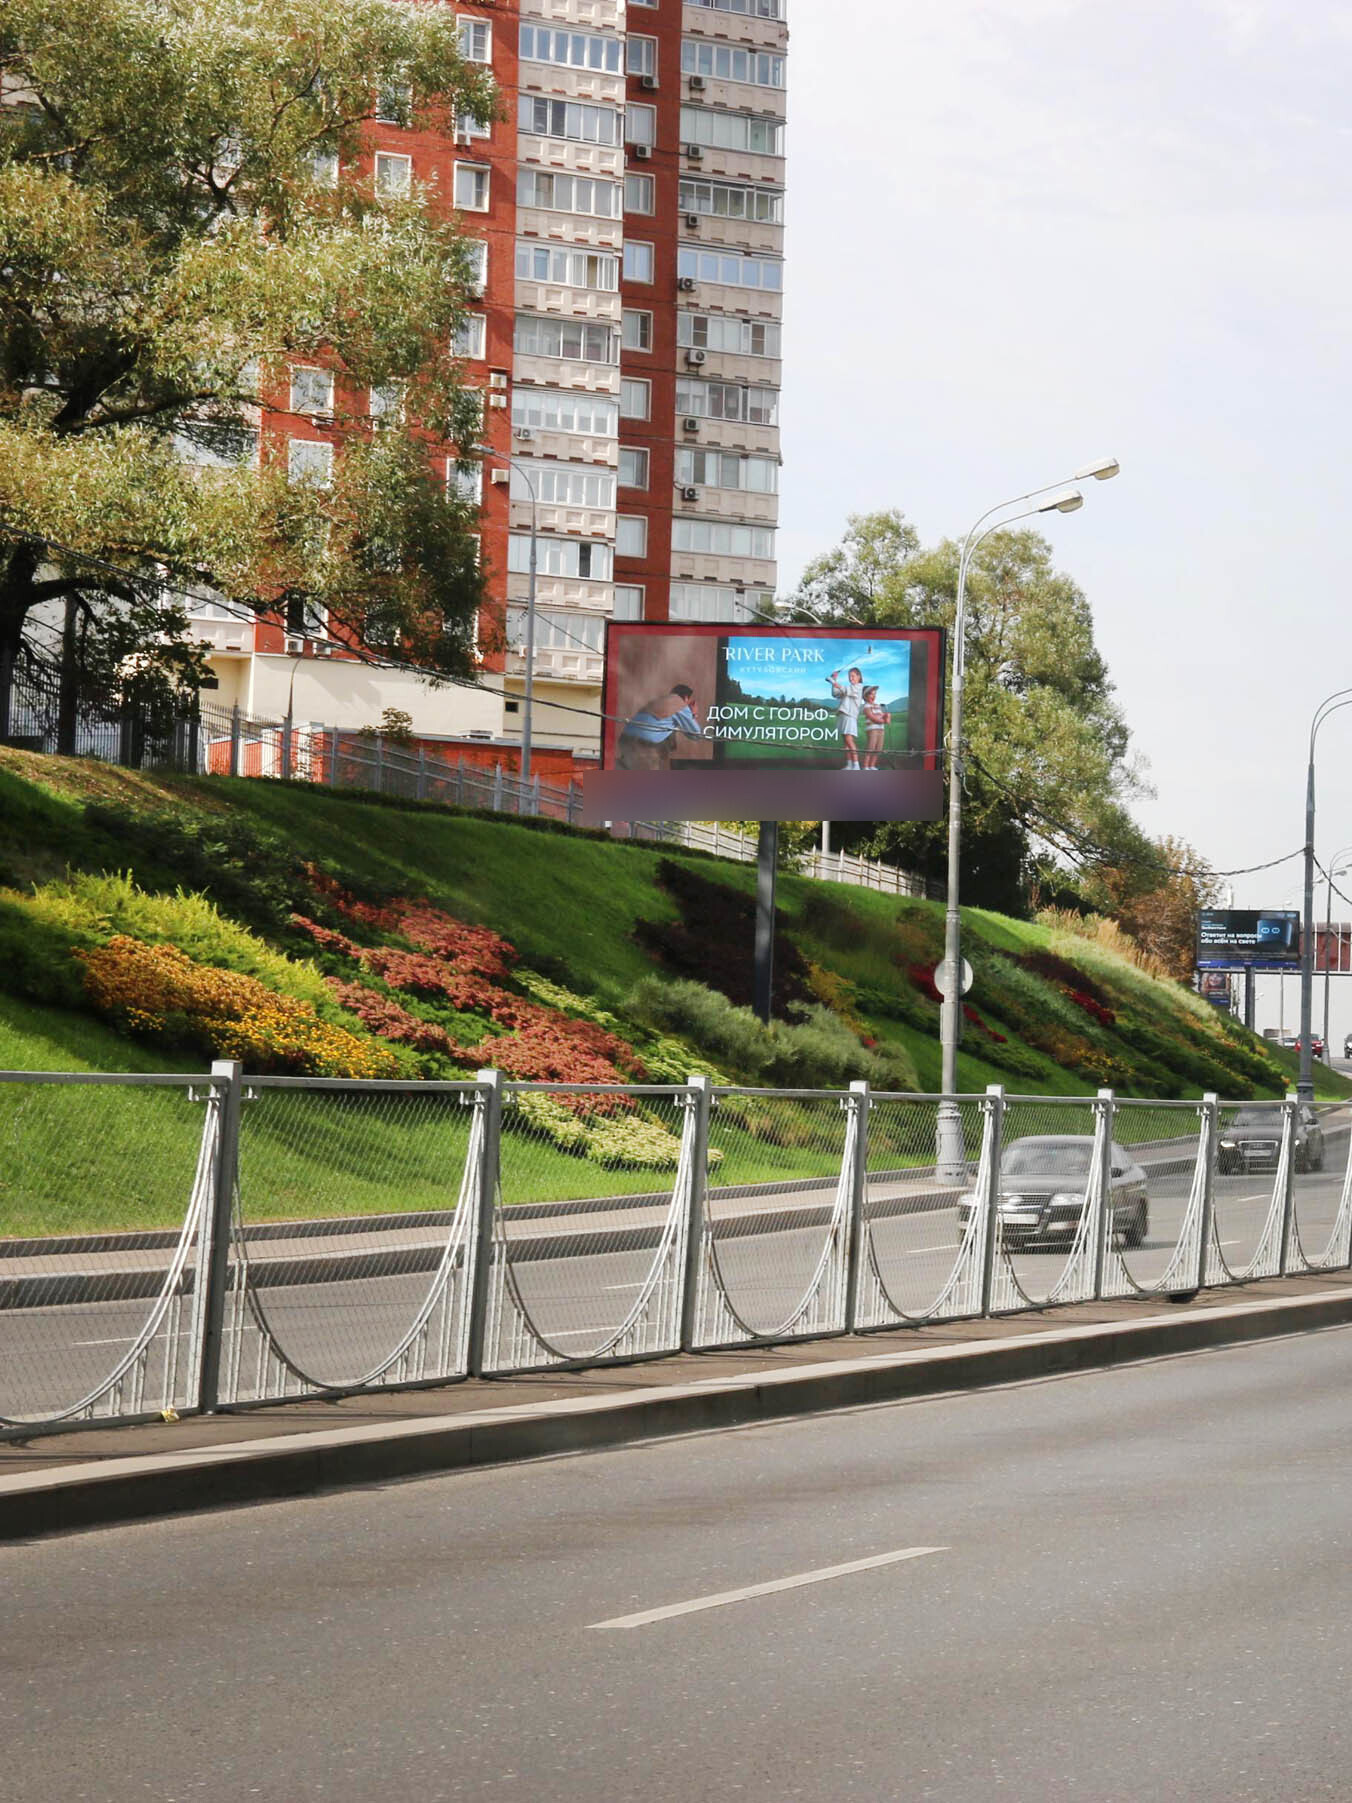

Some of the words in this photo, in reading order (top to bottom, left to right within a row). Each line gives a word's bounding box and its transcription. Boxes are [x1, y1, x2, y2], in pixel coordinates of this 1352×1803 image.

[722, 646, 775, 662] RIVER
[782, 647, 825, 663] PARK
[707, 706, 748, 722] ДОМ
[753, 706, 765, 720] С
[769, 707, 837, 721] ГОЛЬФ-
[703, 725, 839, 741] СИМУЛЯТОРОМ
